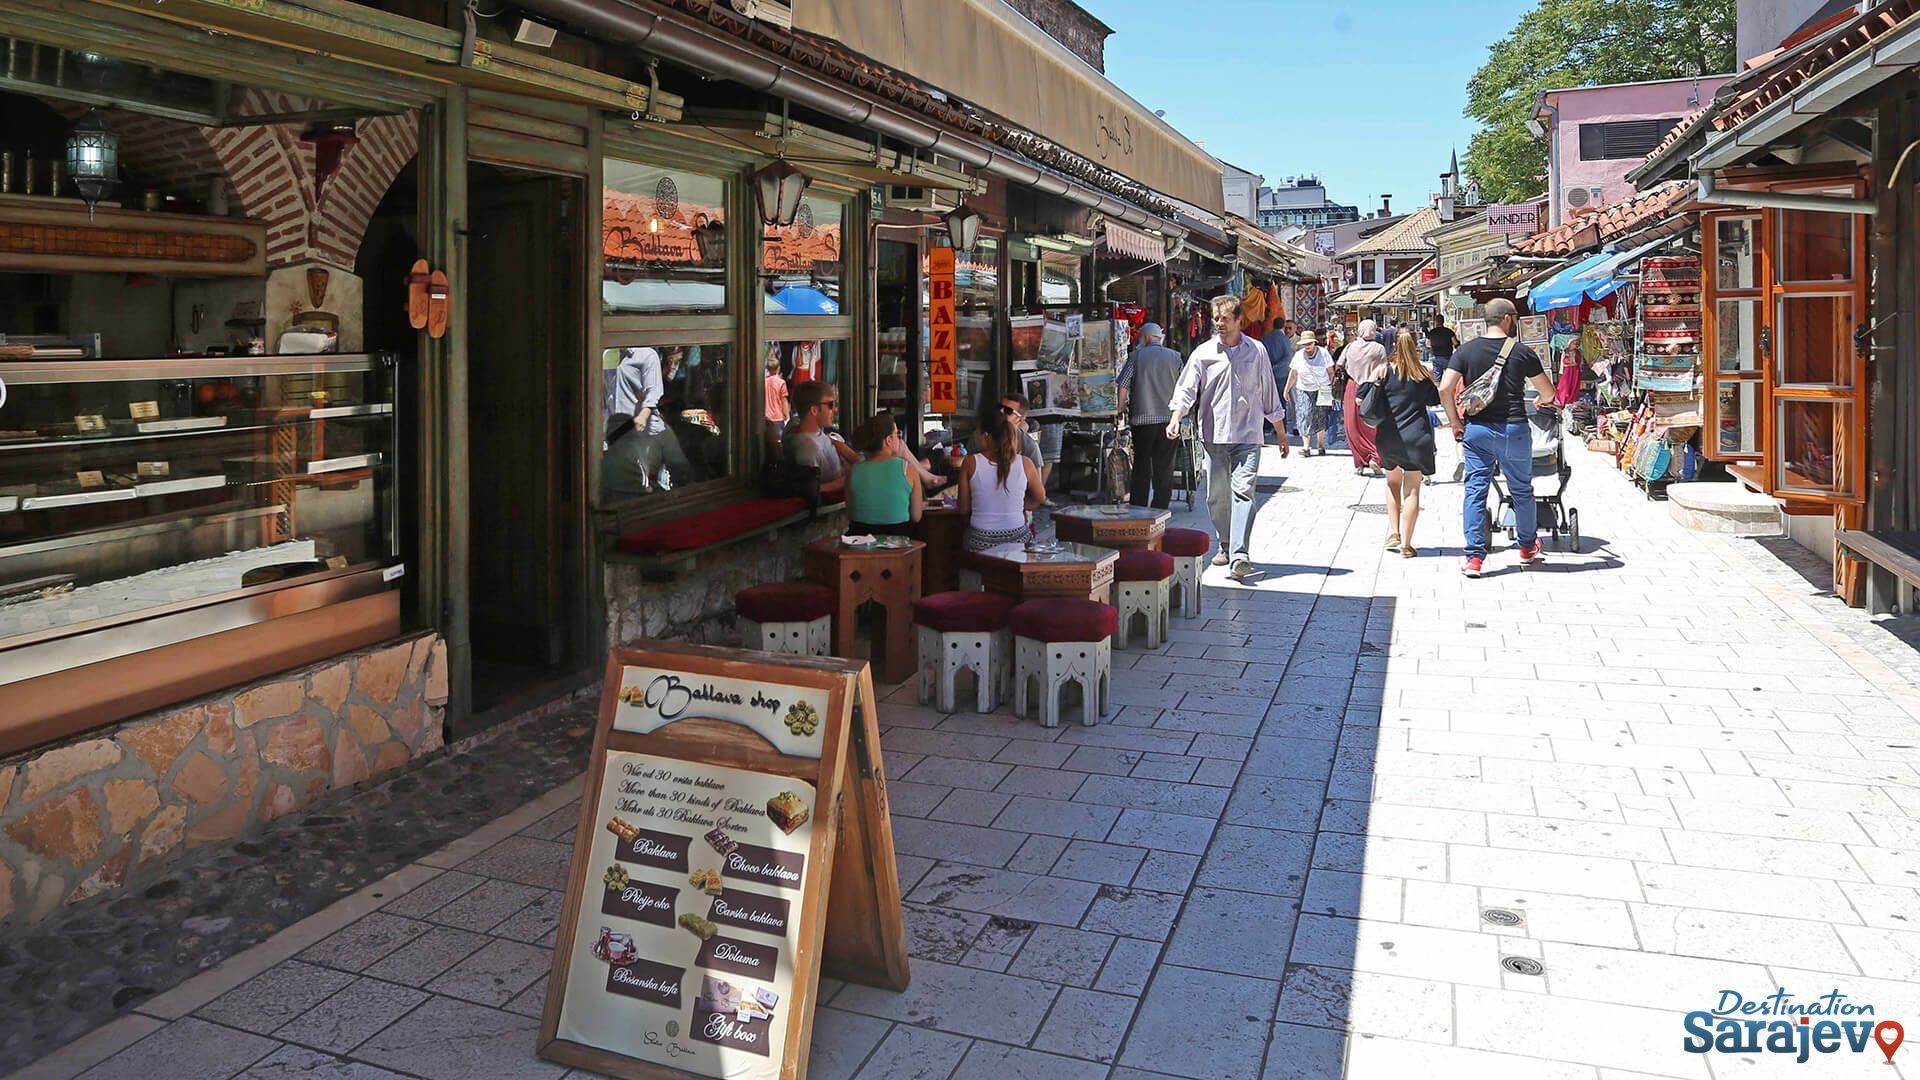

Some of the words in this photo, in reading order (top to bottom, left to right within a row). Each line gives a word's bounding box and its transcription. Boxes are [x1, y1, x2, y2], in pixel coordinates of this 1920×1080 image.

[1489, 213, 1536, 225] MINDER
[933, 280, 953, 401] BAZAR
[645, 674, 744, 719] Baklava
[750, 690, 781, 714] shop
[642, 769, 655, 779] od
[655, 769, 671, 781] 30
[694, 777, 725, 791] baklave
[618, 779, 645, 796] More
[648, 787, 667, 800] than
[669, 790, 687, 802] 30
[686, 793, 709, 808] kinds
[711, 798, 723, 812] of
[724, 797, 766, 817] Baklava
[614, 797, 642, 814] Mehr
[643, 805, 655, 817] als
[656, 807, 673, 819] 30
[674, 807, 714, 828] Baklava
[716, 816, 749, 833] Sorten
[632, 838, 678, 861] Baklava
[728, 852, 760, 874] Choco
[761, 863, 800, 882] baklava
[654, 897, 670, 910] oko
[714, 899, 749, 920] Carska
[749, 910, 784, 928] baklava
[713, 943, 761, 967] Dolama
[612, 967, 658, 990] Bosanska
[658, 980, 679, 998] kafa
[703, 1012, 735, 1041] Gift
[733, 1024, 757, 1043] box
